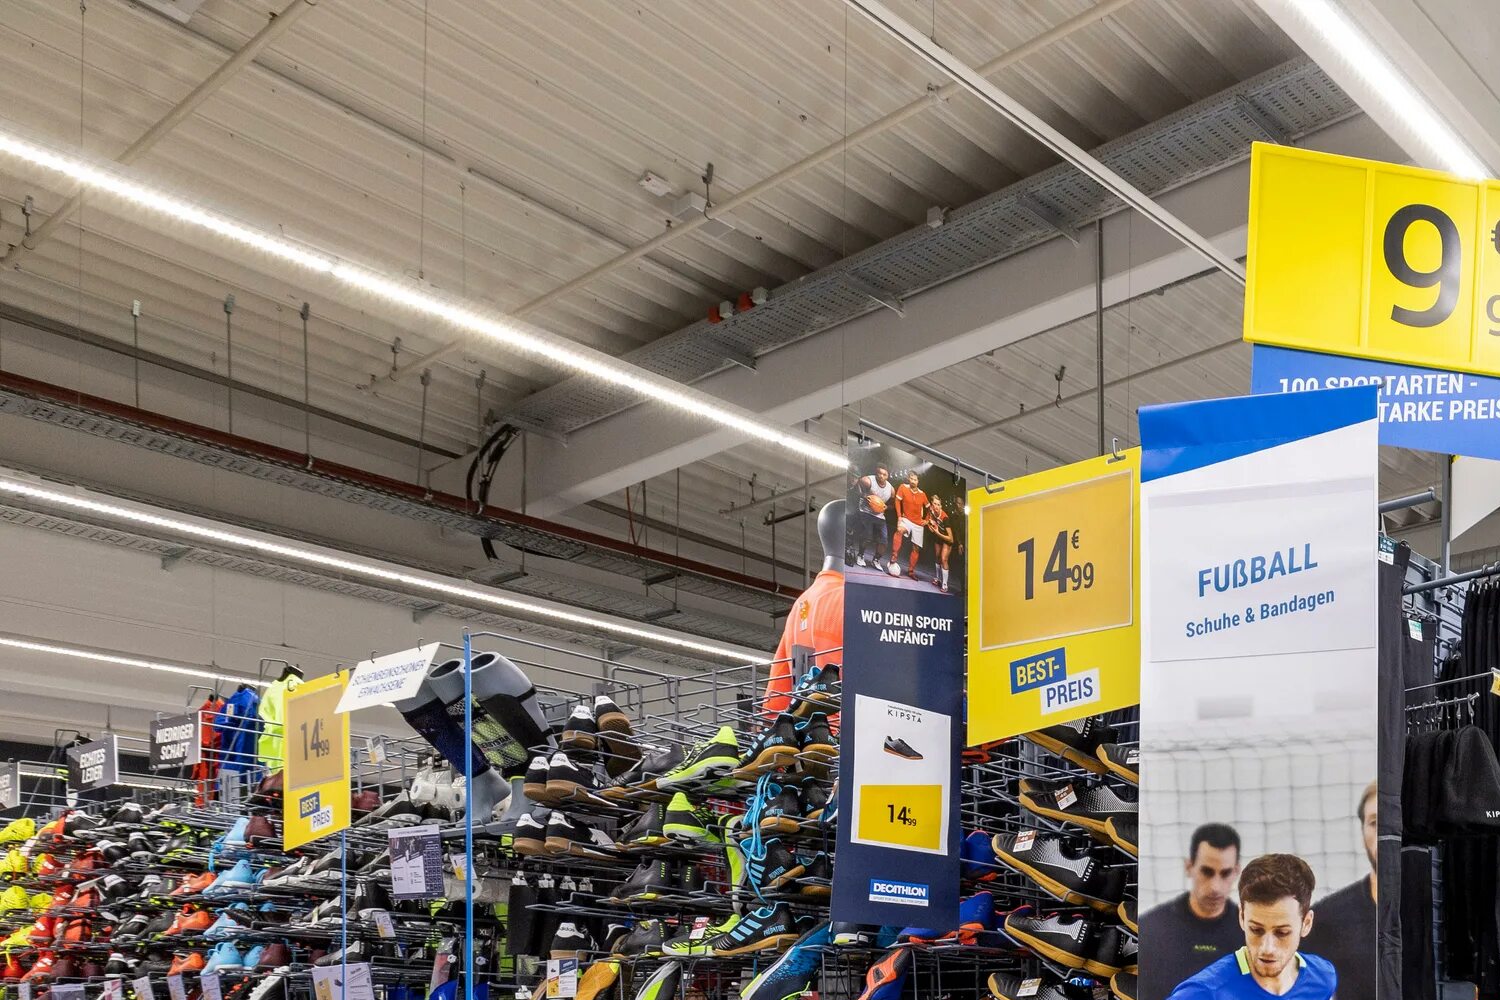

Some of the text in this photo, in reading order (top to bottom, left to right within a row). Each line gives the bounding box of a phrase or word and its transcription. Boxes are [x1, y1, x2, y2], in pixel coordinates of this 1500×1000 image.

[1383, 203, 1462, 328] 9
[1379, 401, 1443, 423] TARKE
[1198, 543, 1318, 598] FUßBALL
[861, 609, 953, 631] WO DEIN SPORT
[1186, 590, 1335, 638] Schuhe & Bandagen
[880, 628, 935, 646] ANFÄNGT
[1016, 656, 1060, 687] BEST-
[1047, 677, 1093, 708] PREIS
[887, 709, 922, 723] KIPSTA
[155, 723, 194, 744] NIEDRIGER
[80, 749, 105, 768] ECHTES
[159, 742, 190, 760] SCHAFT
[81, 765, 103, 784] LEDER
[312, 809, 330, 827] PREIS
[873, 882, 926, 897] DECATHLON
